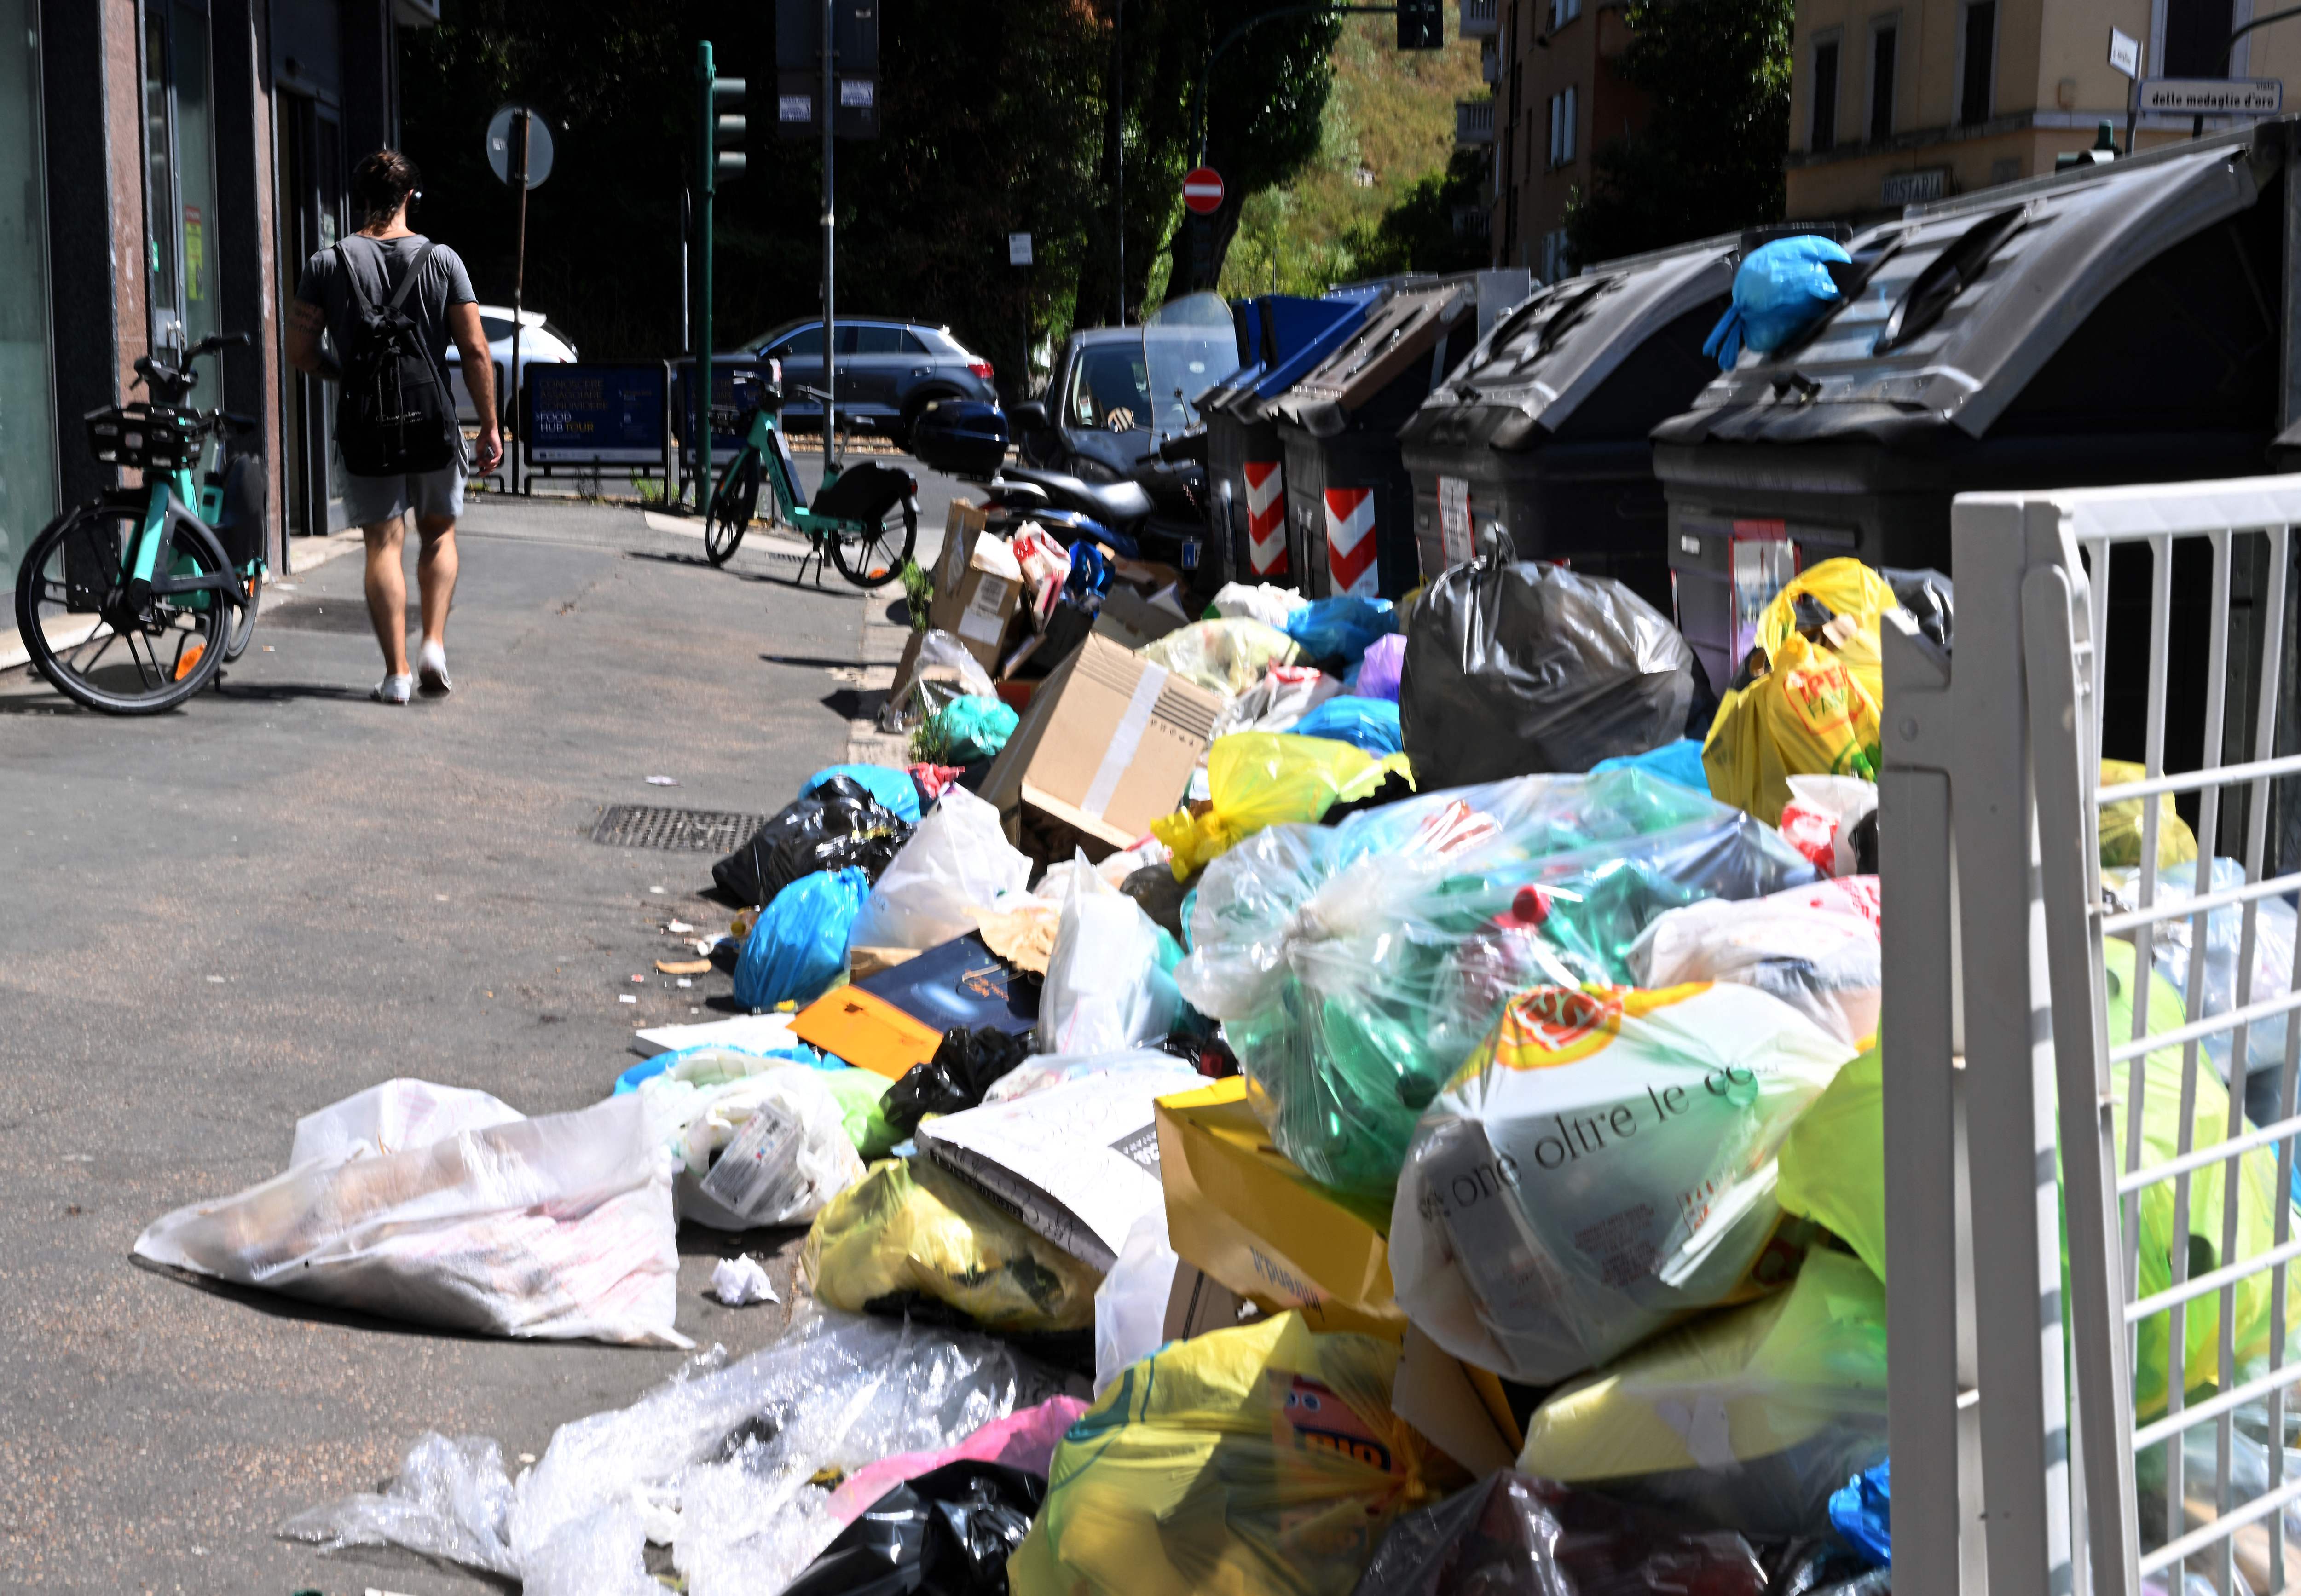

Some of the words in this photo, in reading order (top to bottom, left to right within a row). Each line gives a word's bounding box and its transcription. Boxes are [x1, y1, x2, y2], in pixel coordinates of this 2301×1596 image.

[2152, 92, 2182, 107] delle
[2187, 92, 2240, 110] medaglie
[2245, 92, 2274, 108] d'oro
[1883, 173, 1941, 205] HOSTARIA
[540, 411, 572, 422] FOOD
[541, 422, 563, 433] HUB
[566, 422, 594, 433] TOUR
[1535, 1105, 1636, 1169] oltre
[1647, 1083, 1689, 1123] le
